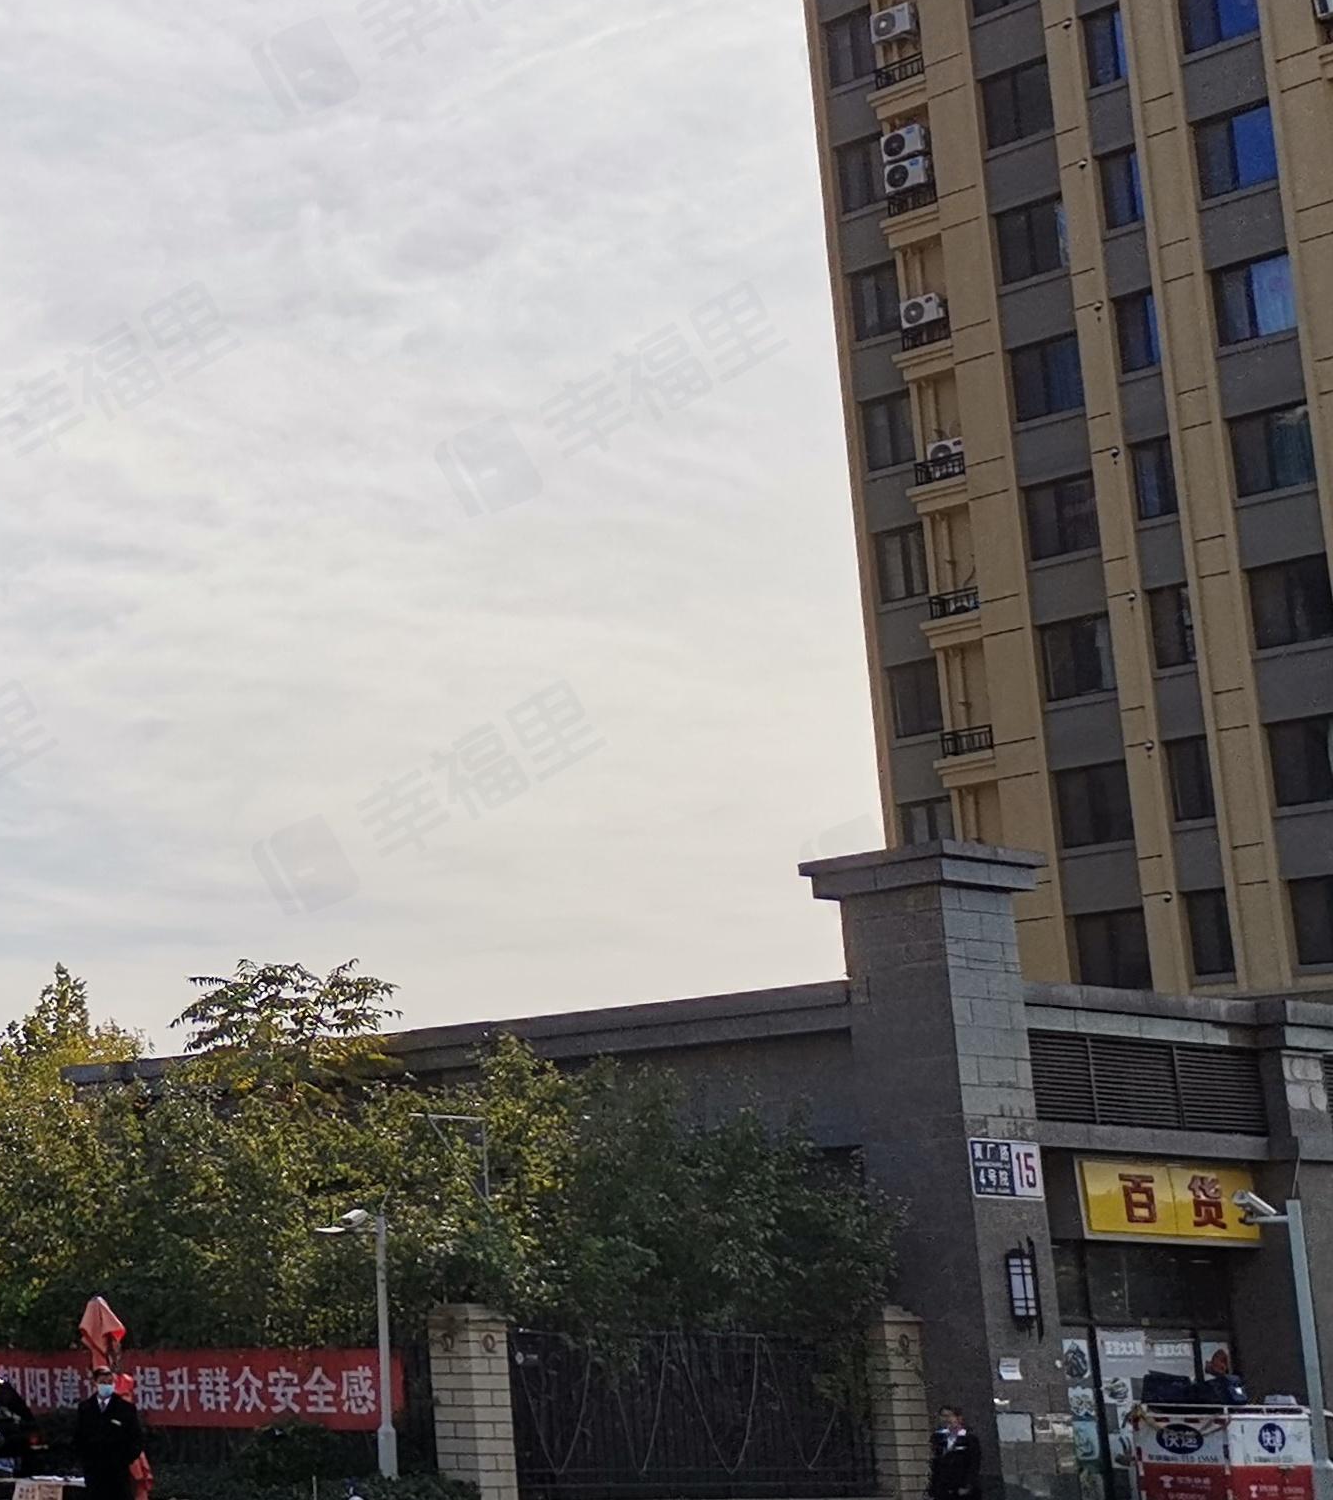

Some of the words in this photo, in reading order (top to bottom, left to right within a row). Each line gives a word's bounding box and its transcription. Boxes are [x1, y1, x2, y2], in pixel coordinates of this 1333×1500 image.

[1015, 1151, 1037, 1188] 15
[1118, 1172, 1227, 1230] 百货
[134, 1365, 376, 1416] 提升群众安全感
